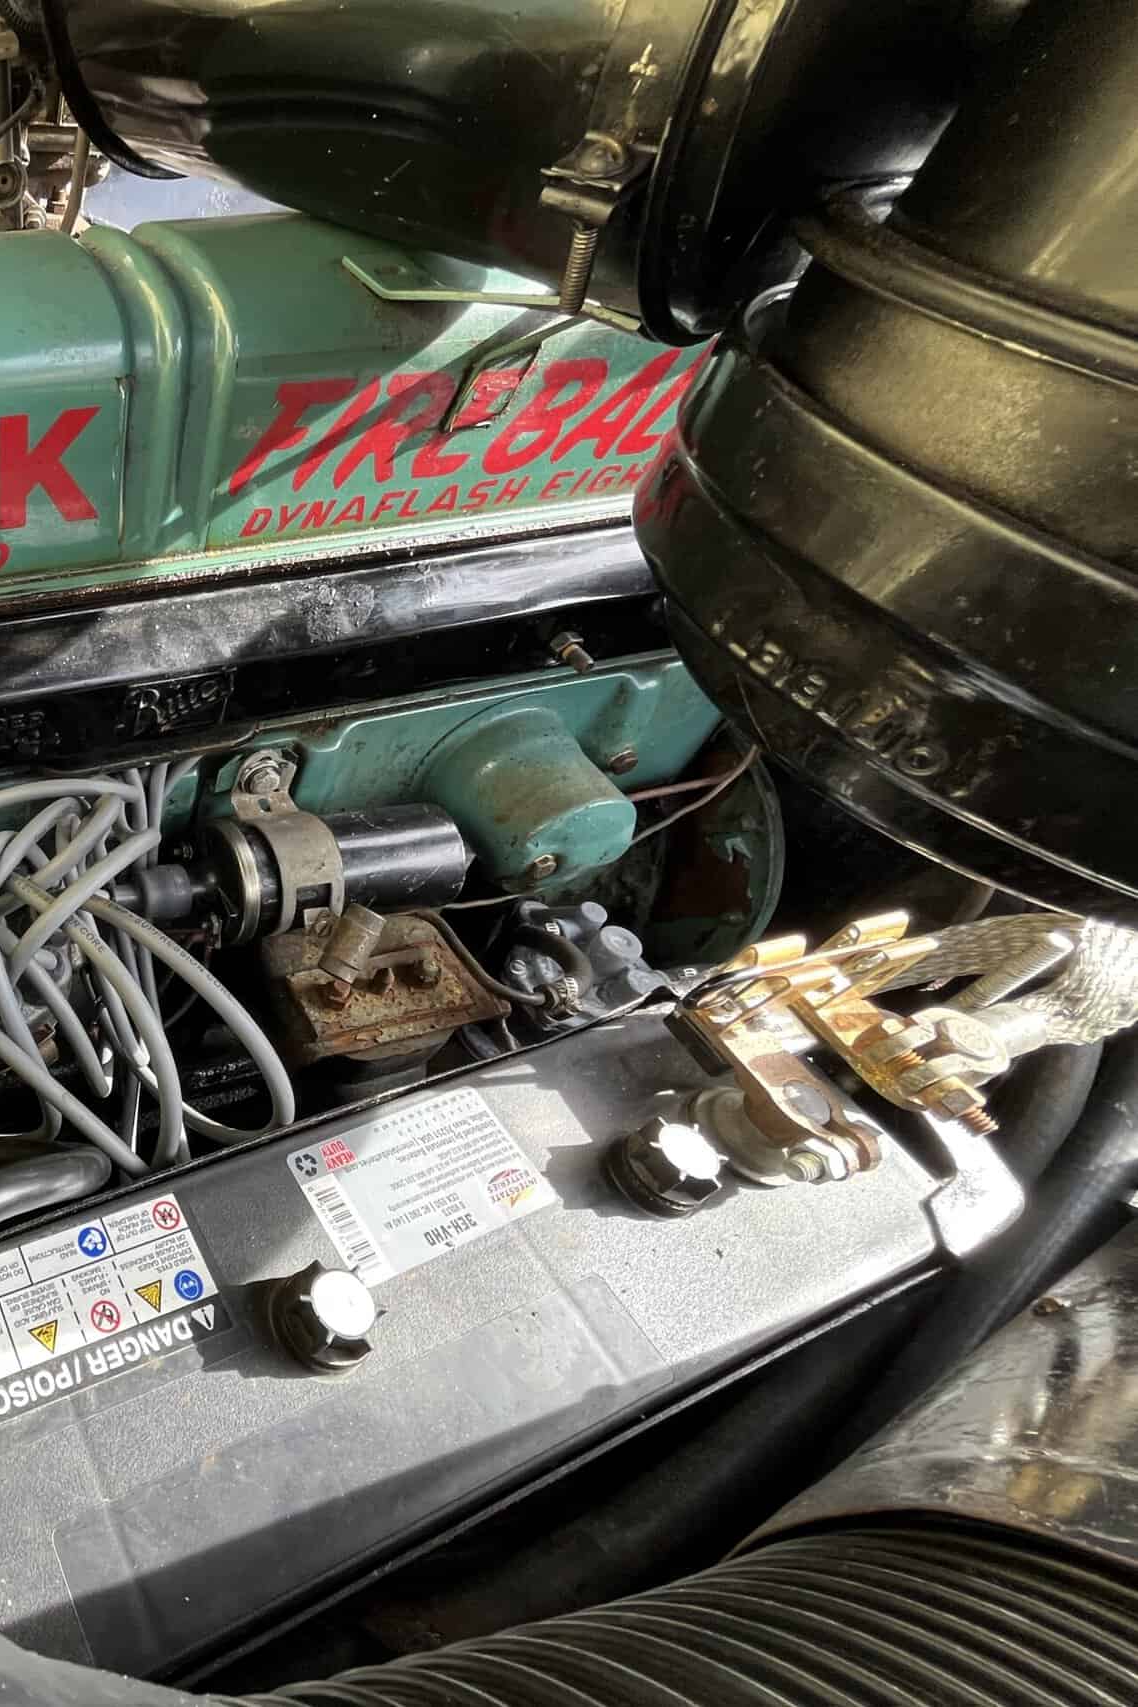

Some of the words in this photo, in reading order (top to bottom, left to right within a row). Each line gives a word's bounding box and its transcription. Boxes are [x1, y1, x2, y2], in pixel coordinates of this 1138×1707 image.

[229, 336, 714, 497] FIREBAL
[238, 475, 530, 538] DYNAFLASH
[538, 461, 652, 501] EIGH
[79, 926, 106, 954] CORE
[320, 1139, 350, 1158] DUTY
[324, 1148, 358, 1171] HEAVY
[485, 1169, 530, 1193] BATTERIES
[488, 1177, 538, 1203] INTERSTATE
[422, 1213, 477, 1246] 3EH-VHD
[85, 1315, 195, 1376] DANGER
